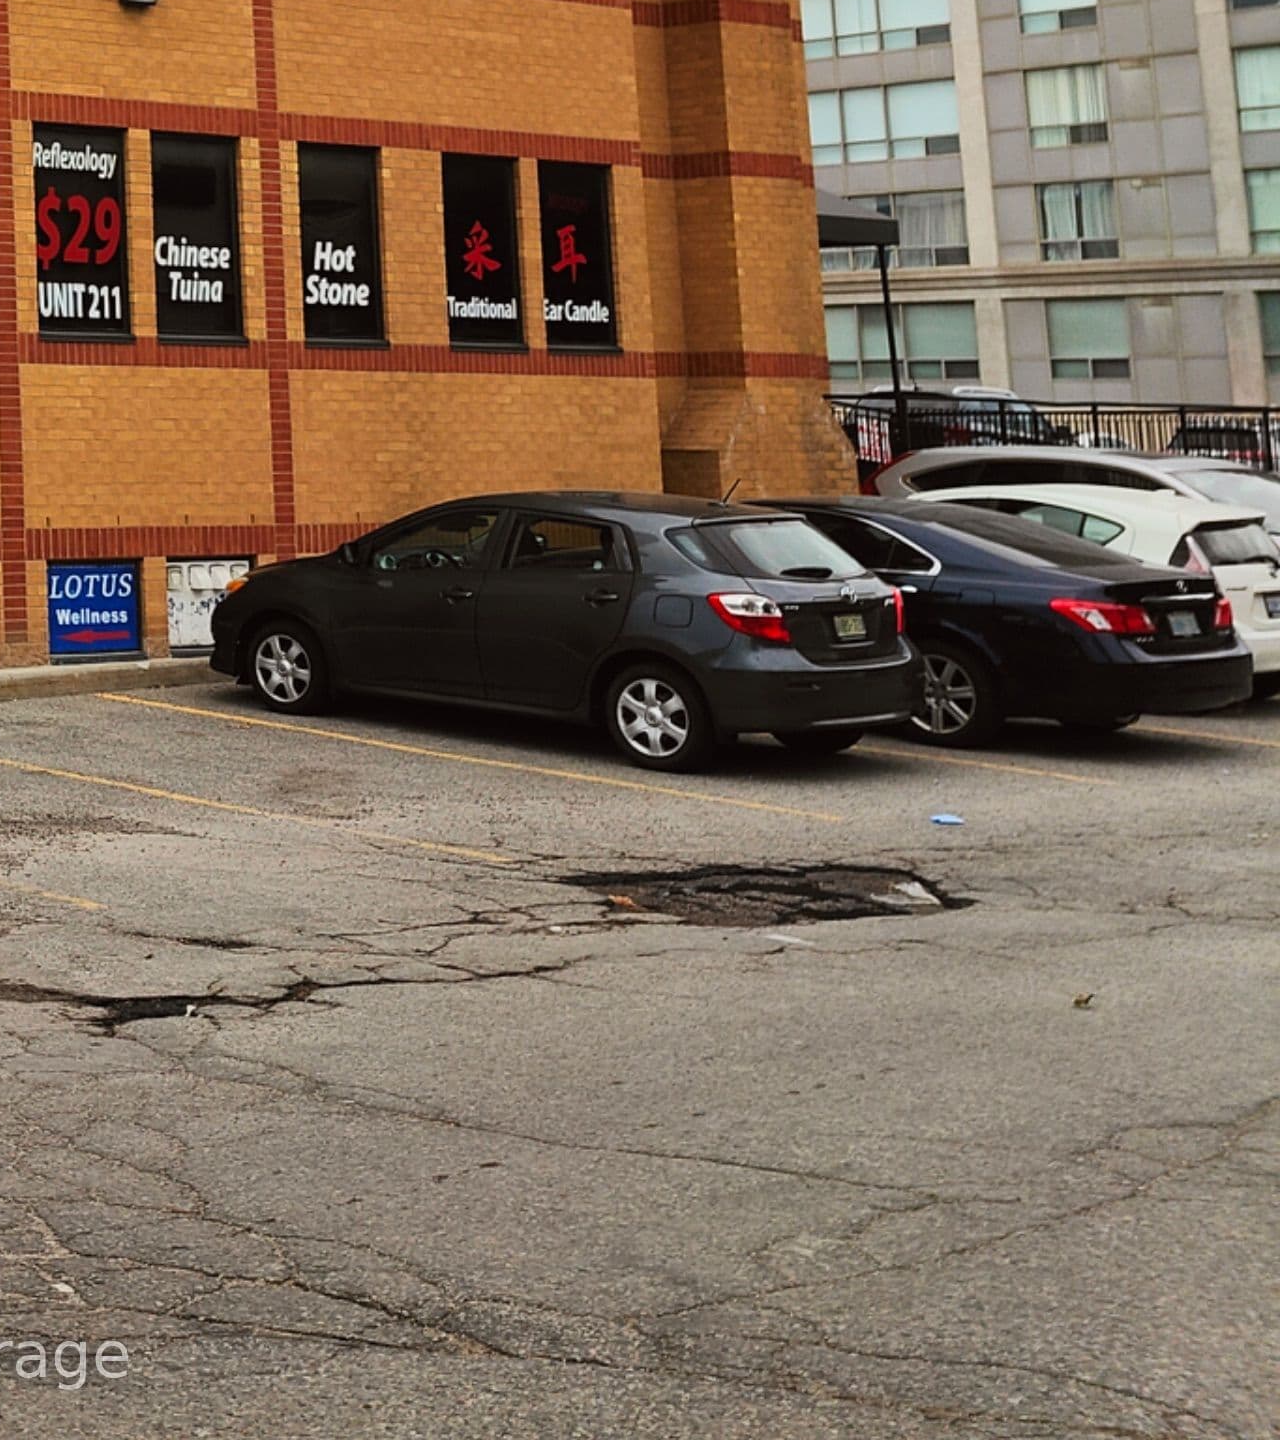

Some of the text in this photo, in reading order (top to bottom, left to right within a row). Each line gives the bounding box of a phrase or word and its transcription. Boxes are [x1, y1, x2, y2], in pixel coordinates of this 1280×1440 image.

[33, 141, 116, 179] Reflexology
[37, 186, 121, 271] $29
[154, 236, 230, 270] Chinese
[314, 241, 356, 272] Hot
[551, 224, 587, 284] 耳
[38, 282, 122, 320] UNIT 211
[169, 271, 223, 303] Tuina
[305, 274, 370, 306] Stone
[446, 296, 518, 320] Traditional
[543, 299, 610, 323] Ear Candle
[49, 573, 132, 600] LOTUS
[55, 608, 129, 626] Wellness
